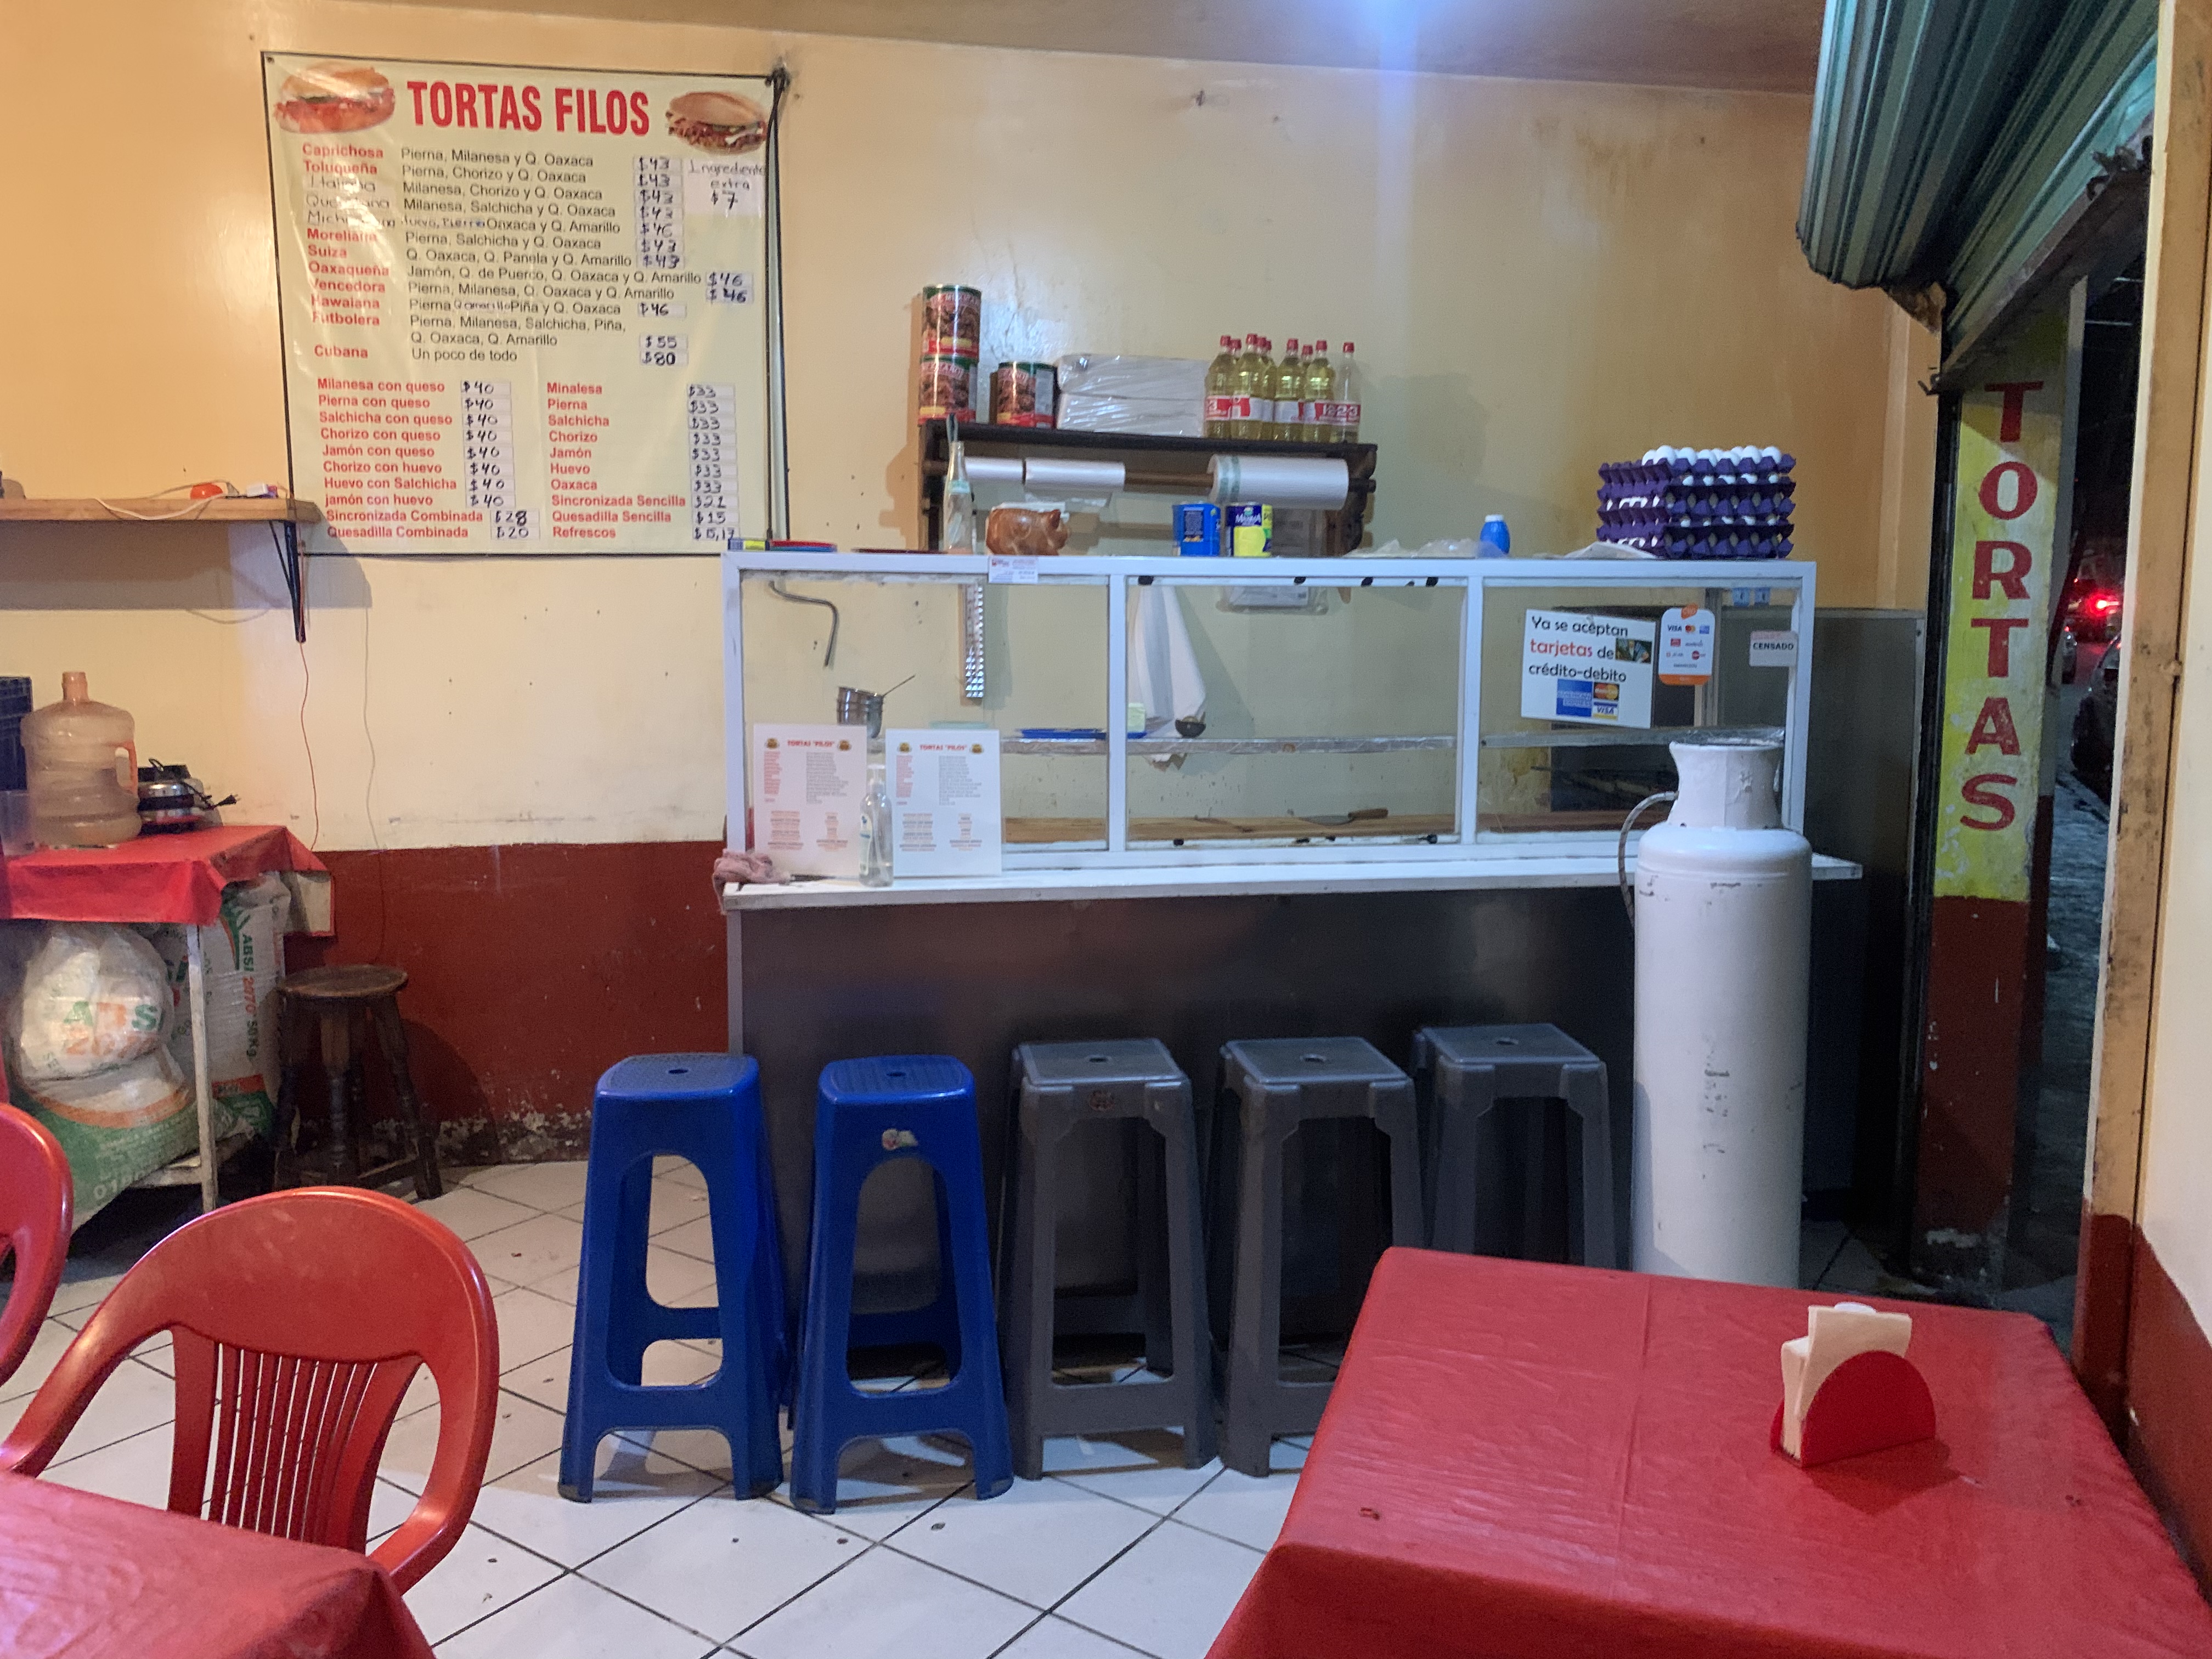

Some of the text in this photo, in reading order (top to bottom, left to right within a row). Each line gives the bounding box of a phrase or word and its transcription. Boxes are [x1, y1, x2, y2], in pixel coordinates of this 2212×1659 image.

[407, 80, 650, 136] TORTAS FILOS
[302, 143, 383, 159] Caprichosa
[400, 148, 594, 167] Pierna, Milanesa y Q. Oaxaca
[303, 159, 378, 176] Toluqueña
[402, 163, 586, 183] Pierna, Chorizo y Q. Oaxaca
[402, 180, 602, 201] Milanesa, Chorizo y Q. Oaxaca
[403, 198, 468, 213] Milanesa,
[470, 200, 533, 215] Salchicha
[537, 206, 544, 218] y
[548, 203, 562, 216] Q.
[567, 204, 616, 217] Oaxaca
[486, 217, 536, 231] Oaxaca
[540, 222, 547, 234] y
[551, 219, 566, 233] Q.
[569, 220, 620, 233] Amarillo
[405, 231, 601, 251] Pierna, Salchicha y Q. Oaxaca
[307, 244, 347, 257] Suiza
[405, 247, 632, 268] Q. Oaxaca, Q. Panela y Q. Amarillo
[308, 259, 389, 277] Oaxaqueña
[408, 264, 702, 285] Jamón, Q. de Puerco, Q. Oaxaca y Q. Amarillo
[408, 281, 675, 301] Pierna, Milanesa, Q. Oaxaca y Q. Amarillo
[510, 300, 539, 313] Piña
[542, 304, 550, 317] y
[553, 301, 568, 314] Q.
[572, 302, 620, 314] Oaxaca
[410, 314, 626, 332] Pierna, Milanesa, Salchicha, Piña,
[410, 331, 557, 346] Q. Oaxaca, Q. Amarillo
[314, 344, 368, 359] Cubana
[411, 347, 517, 363] Un poco de todo
[317, 377, 445, 395] Milanesa con queso
[546, 381, 602, 394] Minalesa
[318, 393, 431, 411] Pierna con queso
[547, 397, 588, 410] Pierna
[319, 410, 453, 427] Salchicha con queso
[548, 414, 610, 426] Salchicha
[320, 427, 441, 443] Chorizo con queso
[549, 429, 598, 443] Chorizo
[322, 444, 435, 459] Jamón con queso
[549, 447, 592, 459] Jamón
[323, 460, 442, 473] Chorizo con huevo
[550, 462, 590, 475] Huevo
[324, 476, 457, 490] Huevo con Salchicha
[550, 478, 597, 490] Oaxaca
[366, 495, 390, 505] con
[393, 493, 433, 506] huevo
[551, 494, 686, 507] Sincronizada Sencilla
[324, 509, 483, 522] Sincronizada Combinada
[552, 510, 672, 522] Quesadilla Sencilla
[325, 525, 469, 539] Quesadilla Combinada
[552, 526, 616, 538] Refrescos
[1959, 381, 2044, 831] TORTAS
[1532, 616, 1628, 636] Ya se aceptan
[1531, 638, 1614, 659] tarjetas de
[1528, 663, 1627, 682] crédito-debito
[243, 934, 254, 972] ABSI
